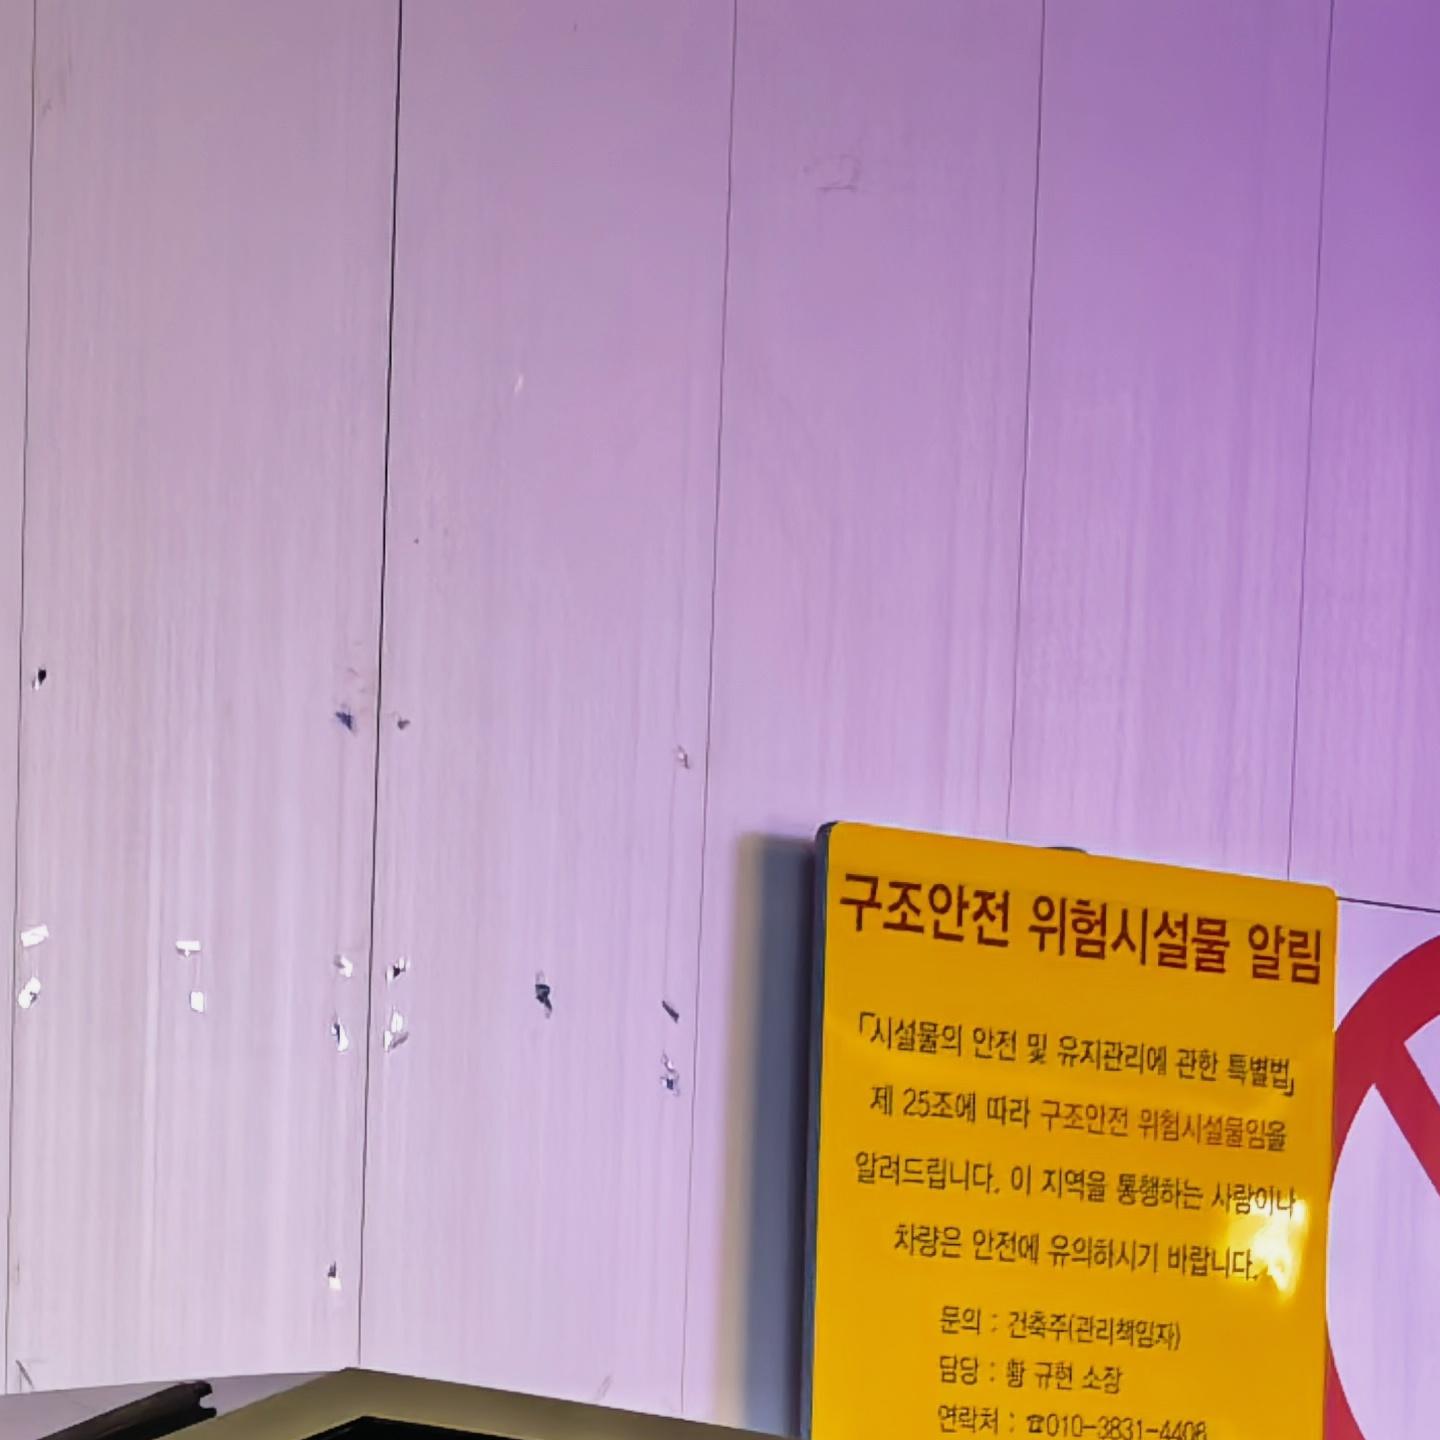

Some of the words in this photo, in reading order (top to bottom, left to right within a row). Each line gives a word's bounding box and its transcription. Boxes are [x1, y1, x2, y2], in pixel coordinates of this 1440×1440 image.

[840, 872, 1009, 949] 구조안전
[1028, 894, 1229, 975] 위험시설물
[1248, 920, 1320, 985] 알림
[973, 1025, 1017, 1060] 안전
[1028, 1032, 1047, 1065] 및
[1058, 1035, 1166, 1077] 유지관리에
[1177, 1047, 1217, 1082] 관한
[871, 1084, 892, 1117] 제
[903, 1086, 976, 1123] 25조에
[988, 1094, 1029, 1127] 따라
[1041, 1099, 1128, 1138] 구조안전
[1139, 1108, 1286, 1153] 위험시설물임을
[856, 1151, 999, 1196] 알려드립니다.
[1011, 1165, 1031, 1195] 이
[1043, 1170, 1106, 1202] 지역을
[1119, 1173, 1202, 1211] 통행하는
[1212, 1179, 1296, 1219] 사람이나
[895, 1222, 960, 1258] 차량은
[973, 1230, 1039, 1264] 안전에
[1048, 1235, 1158, 1275] 유의하시기
[1168, 1247, 1258, 1282] 바랍니다.
[941, 1306, 979, 1336] 문의
[1008, 1308, 1180, 1352] 건축주(관리책임자)
[939, 1354, 979, 1386] 담당
[1035, 1362, 1073, 1392] 규현
[1083, 1366, 1123, 1396] 소장
[938, 1405, 999, 1435] 연락처
